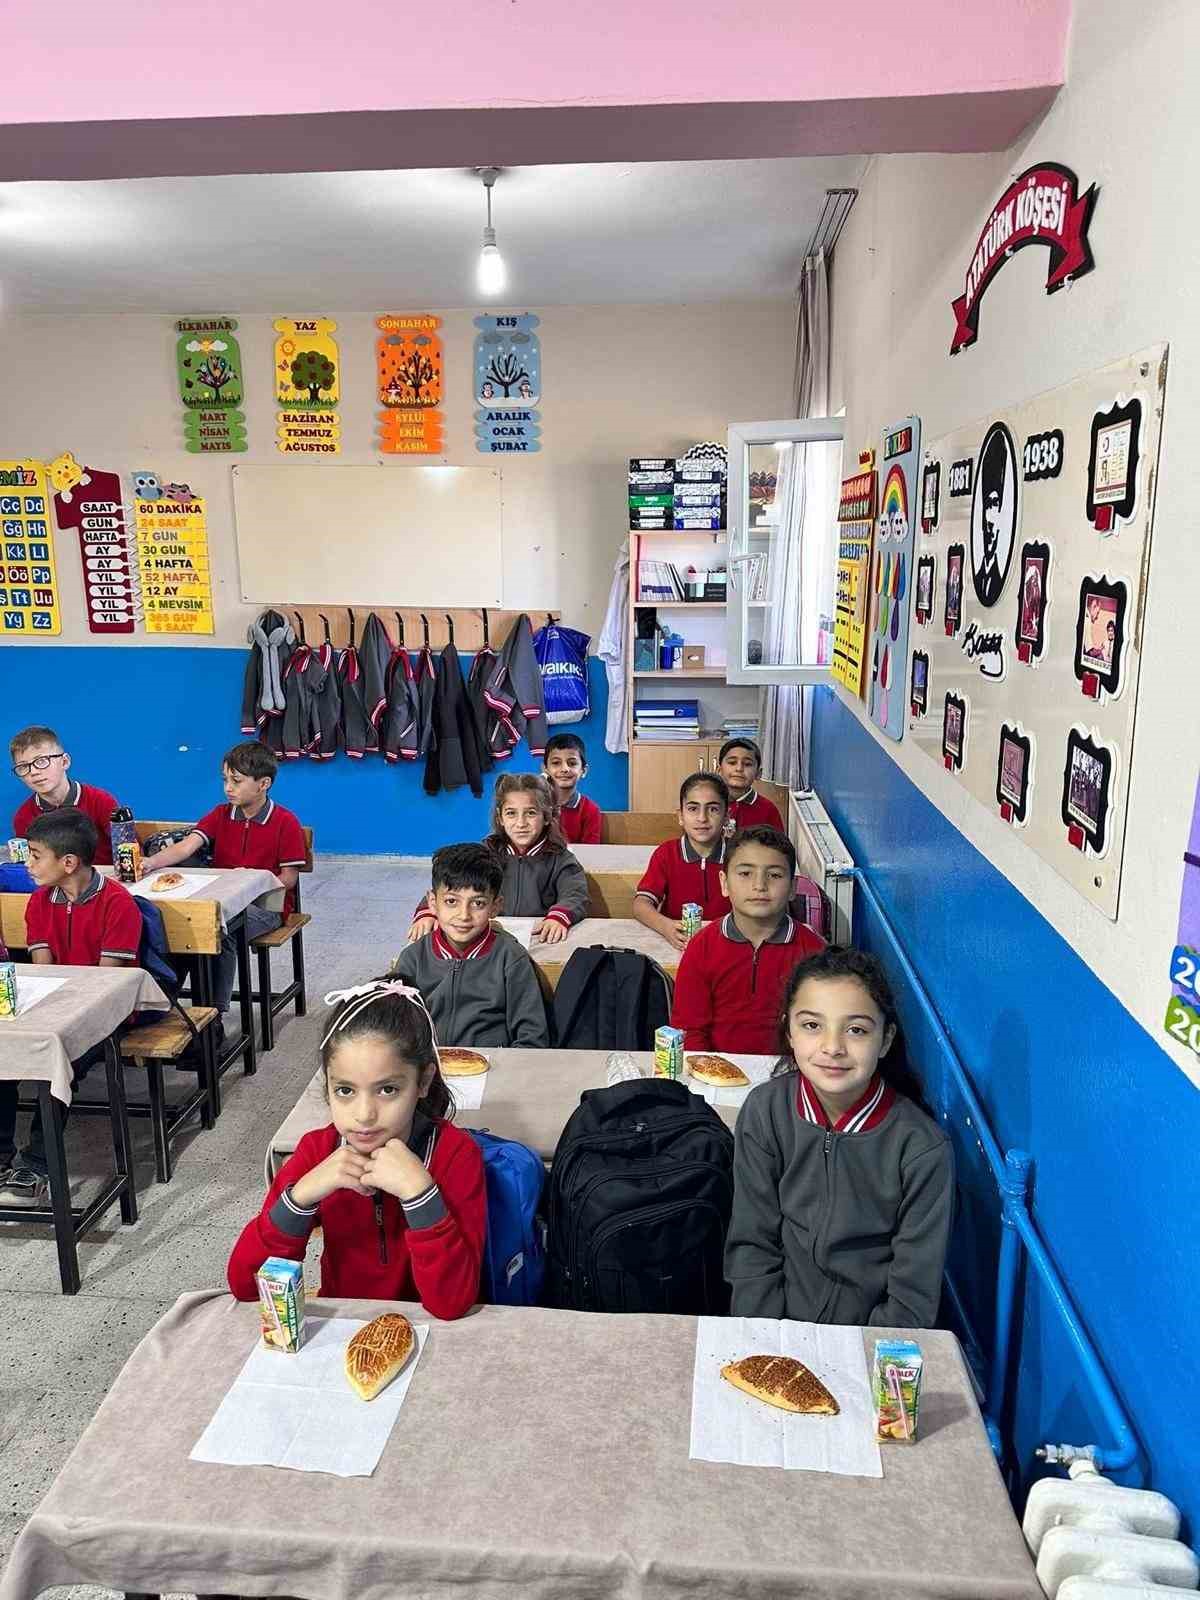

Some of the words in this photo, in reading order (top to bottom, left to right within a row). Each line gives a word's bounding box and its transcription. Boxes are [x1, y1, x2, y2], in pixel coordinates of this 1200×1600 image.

[966, 199, 1015, 309] ATATÜRK
[1015, 177, 1068, 235] KÖŞESİ
[294, 322, 316, 330] YAZ
[496, 317, 518, 327] KIŞ
[200, 413, 228, 422] MART
[283, 413, 334, 423] HAZİRAN
[486, 412, 531, 421] ARALIK
[286, 428, 333, 438] TEMMUZ
[492, 427, 526, 436] OCAK
[285, 442, 336, 452] AĞUSTOS
[490, 442, 528, 452] ŞUBAT
[1024, 437, 1060, 474] 1938
[950, 465, 970, 490] 1881
[25, 499, 44, 512] Dd
[82, 503, 114, 512] SAAT
[140, 504, 154, 514] 60
[156, 504, 202, 514] DAKİKA
[140, 518, 154, 528] 24
[158, 518, 188, 528] SAAT
[27, 522, 46, 536] Hh
[85, 532, 118, 541] HAFTA
[140, 532, 148, 540] 7
[95, 546, 111, 554] AY
[143, 546, 157, 554] 30
[97, 560, 112, 568] AY
[144, 560, 152, 568] 4
[155, 560, 193, 568] HAFTA
[96, 573, 116, 582] YIL
[145, 572, 160, 582] 52
[164, 572, 200, 582] HAFTA
[98, 586, 118, 596] YIL
[146, 586, 160, 596] 12
[164, 586, 178, 596] AY
[12, 592, 28, 604] Tt
[100, 600, 120, 608] YIL
[148, 600, 156, 608] 4
[158, 599, 204, 609] MEVSİM
[32, 614, 50, 627] Zz
[102, 614, 120, 622] YIL
